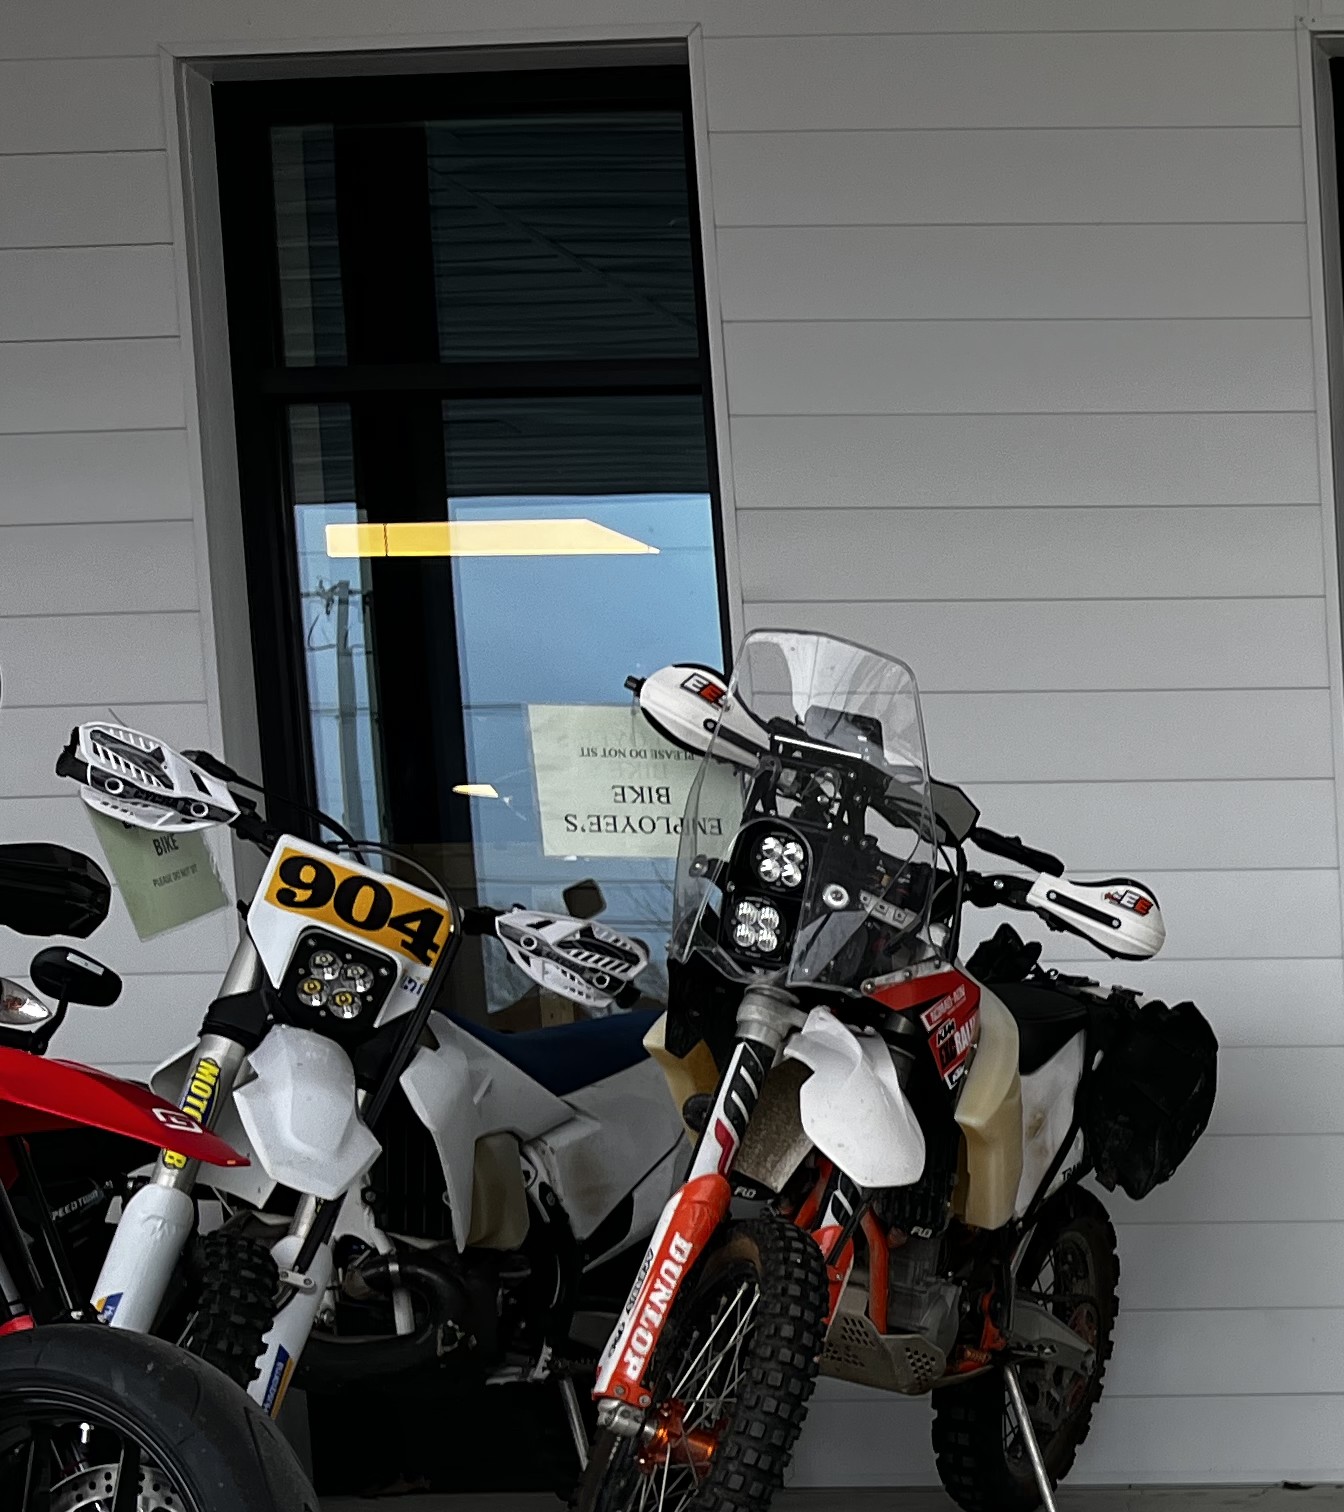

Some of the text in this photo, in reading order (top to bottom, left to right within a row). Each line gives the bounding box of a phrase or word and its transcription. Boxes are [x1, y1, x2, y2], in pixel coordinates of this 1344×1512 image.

[578, 746, 696, 761] PLEASE DO NOT SIT
[611, 784, 671, 805] BIKE
[152, 832, 179, 857] BIKE
[275, 855, 444, 967] 904
[623, 1231, 694, 1381] DUNLOP
